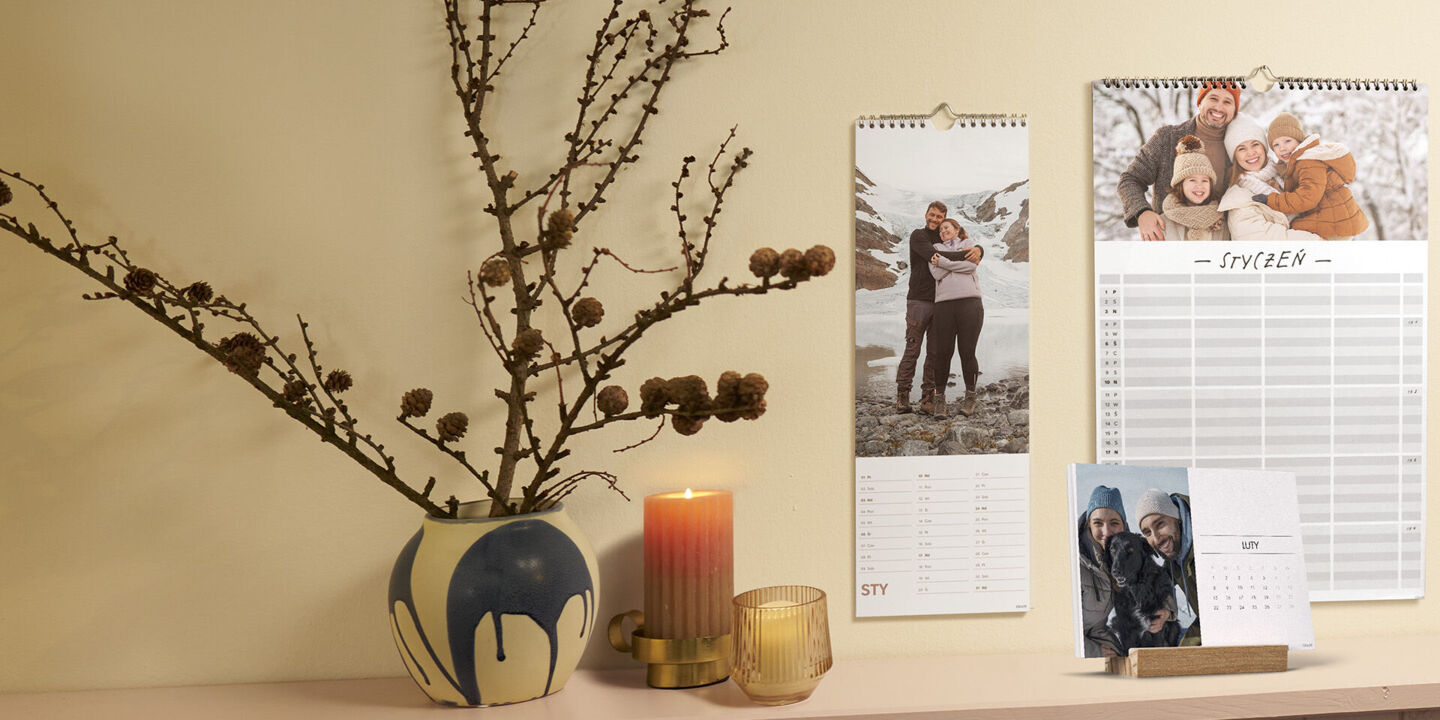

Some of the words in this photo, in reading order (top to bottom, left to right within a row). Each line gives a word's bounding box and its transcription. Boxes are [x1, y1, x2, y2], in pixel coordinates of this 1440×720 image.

[1219, 249, 1306, 270] STYCZEŃ
[1242, 541, 1259, 550] LUTY
[861, 583, 888, 596] STY
